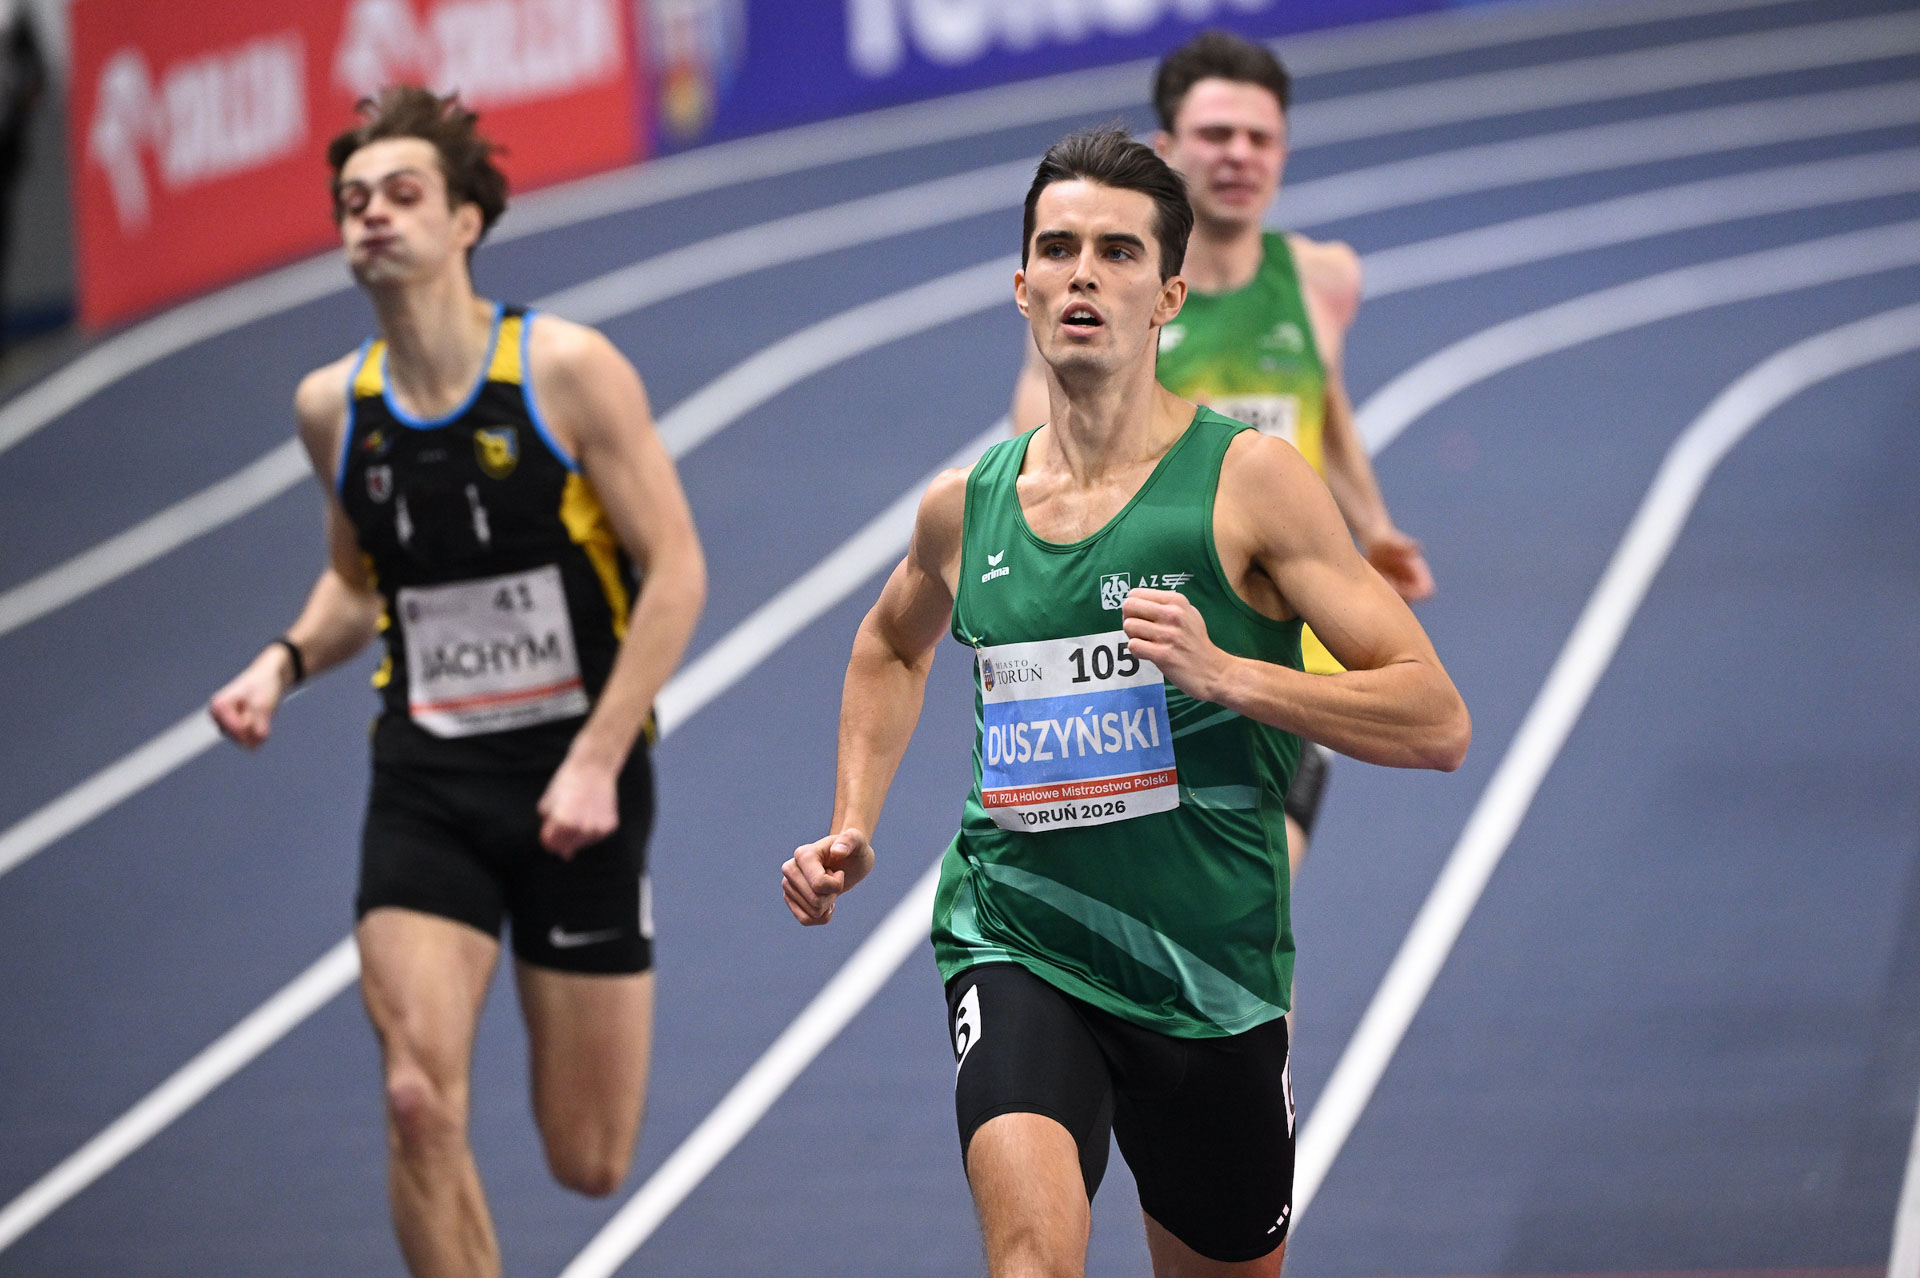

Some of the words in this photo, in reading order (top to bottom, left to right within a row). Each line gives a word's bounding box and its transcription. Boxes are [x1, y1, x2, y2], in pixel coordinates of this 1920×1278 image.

[982, 566, 1010, 584] erima
[995, 659, 1030, 670] MIASTO
[997, 664, 1043, 685] TORUŃ
[1068, 641, 1141, 684] 105
[988, 706, 1160, 767] DUSZYŃSKI
[987, 793, 999, 805] 70.
[1000, 792, 1019, 804] PZLA
[1020, 788, 1060, 803] Halowe
[1062, 781, 1132, 798] Mistrzostwa
[1135, 773, 1169, 788] Polski
[1018, 803, 1078, 826] TORUŃ
[1081, 800, 1127, 820] 2026
